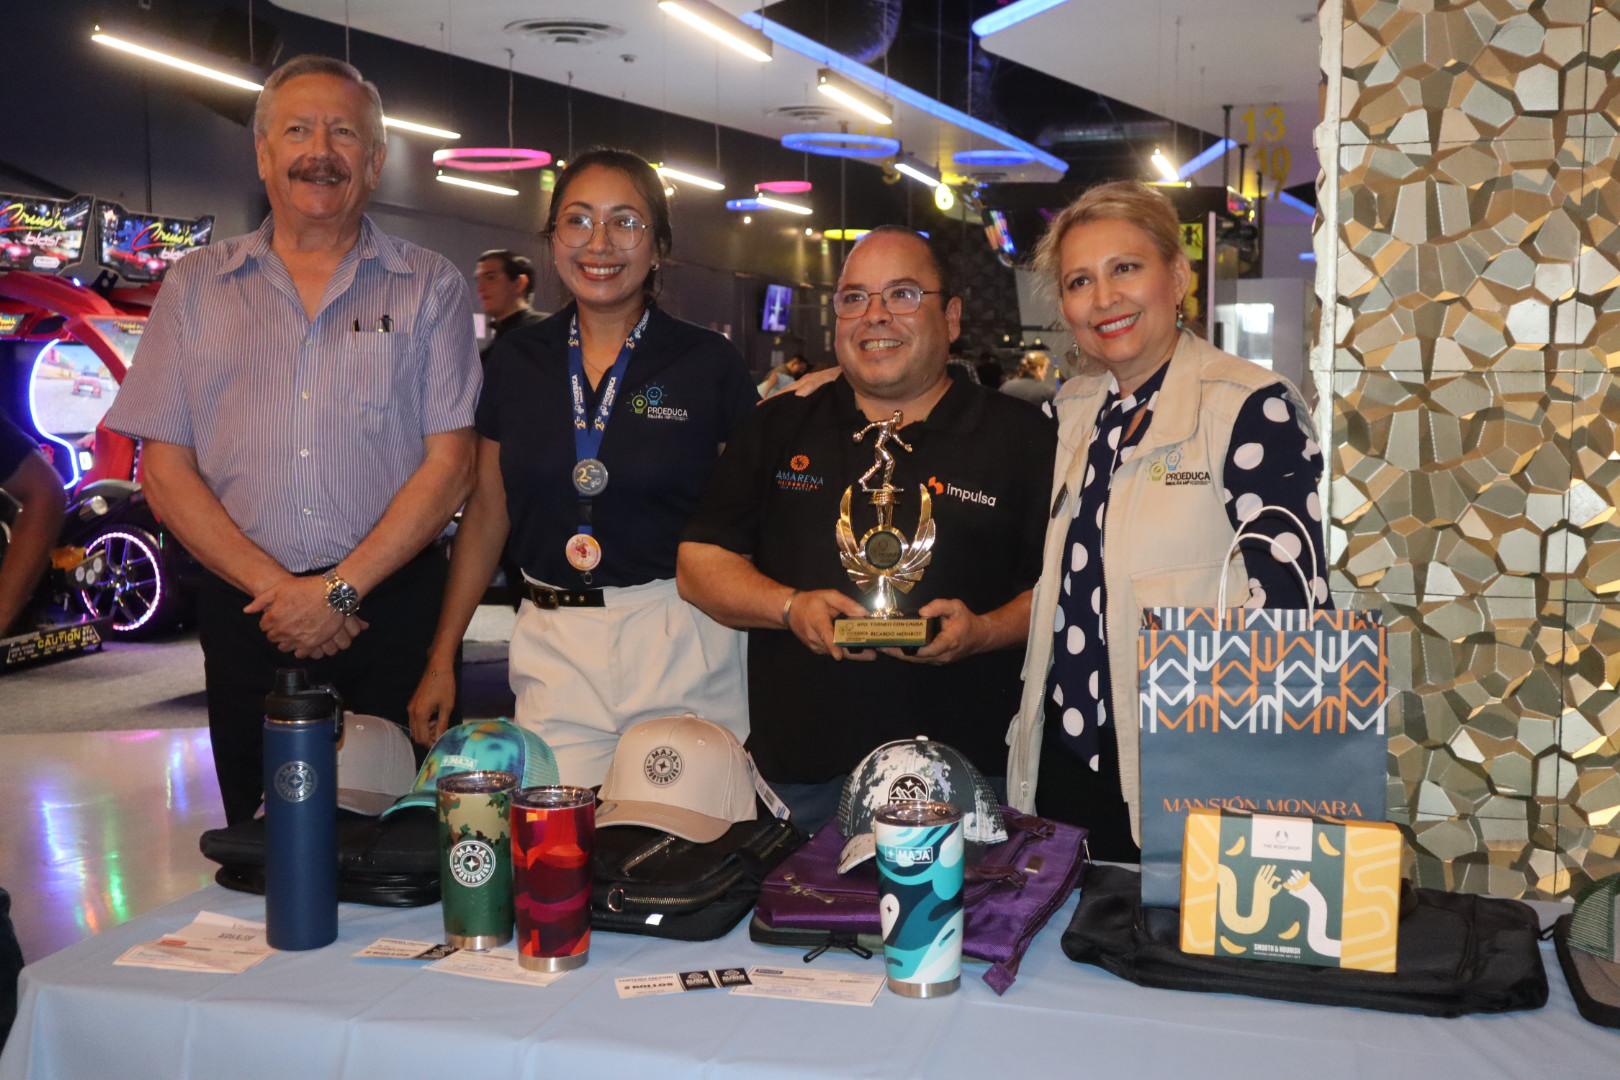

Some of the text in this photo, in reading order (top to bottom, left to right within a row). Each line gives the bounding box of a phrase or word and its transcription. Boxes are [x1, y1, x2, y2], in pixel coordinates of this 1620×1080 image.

[1240, 106, 1287, 143] 13
[647, 406, 688, 417] PROEDUCA
[776, 470, 824, 487] AMARENA
[1165, 471, 1211, 480] PROEDUCA
[946, 484, 996, 507] impulsa
[37, 631, 81, 649] CAUTION
[652, 748, 678, 762] MAJA
[1163, 796, 1363, 817] MANSIÓN MONARA
[456, 845, 487, 858] MAJA
[898, 849, 930, 861] MAJA
[454, 863, 491, 883] SPORTSWEAR
